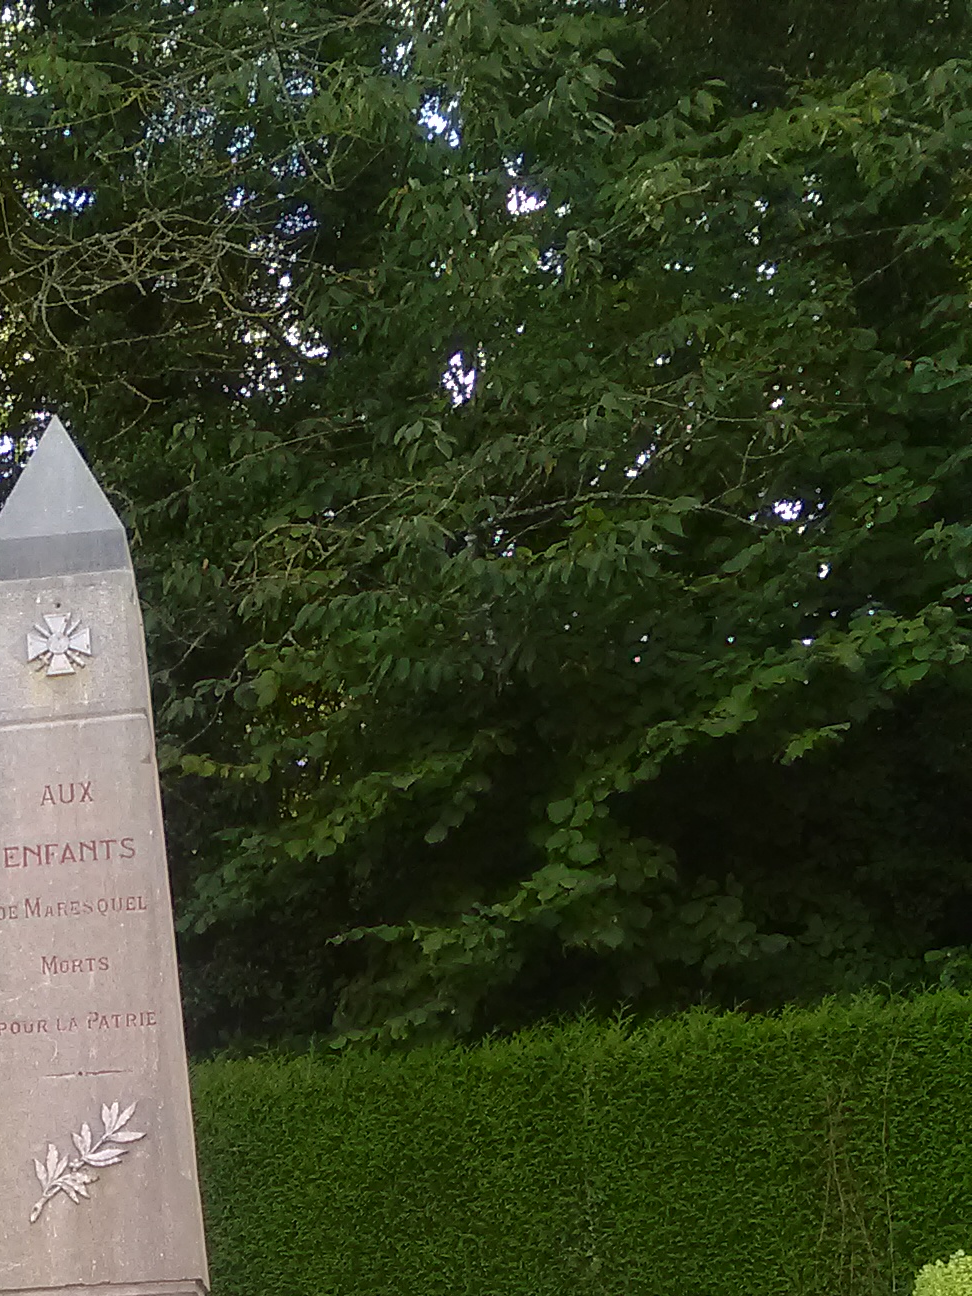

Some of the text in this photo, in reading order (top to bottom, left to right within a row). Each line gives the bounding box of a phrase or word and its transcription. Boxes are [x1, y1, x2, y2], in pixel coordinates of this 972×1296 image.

[40, 781, 94, 806] AUX
[3, 837, 137, 868] ENFANTS
[24, 896, 147, 918] MARESQUEL
[41, 955, 110, 975] MORTS
[56, 1017, 78, 1032] LA
[87, 1011, 157, 1030] PATRIE
